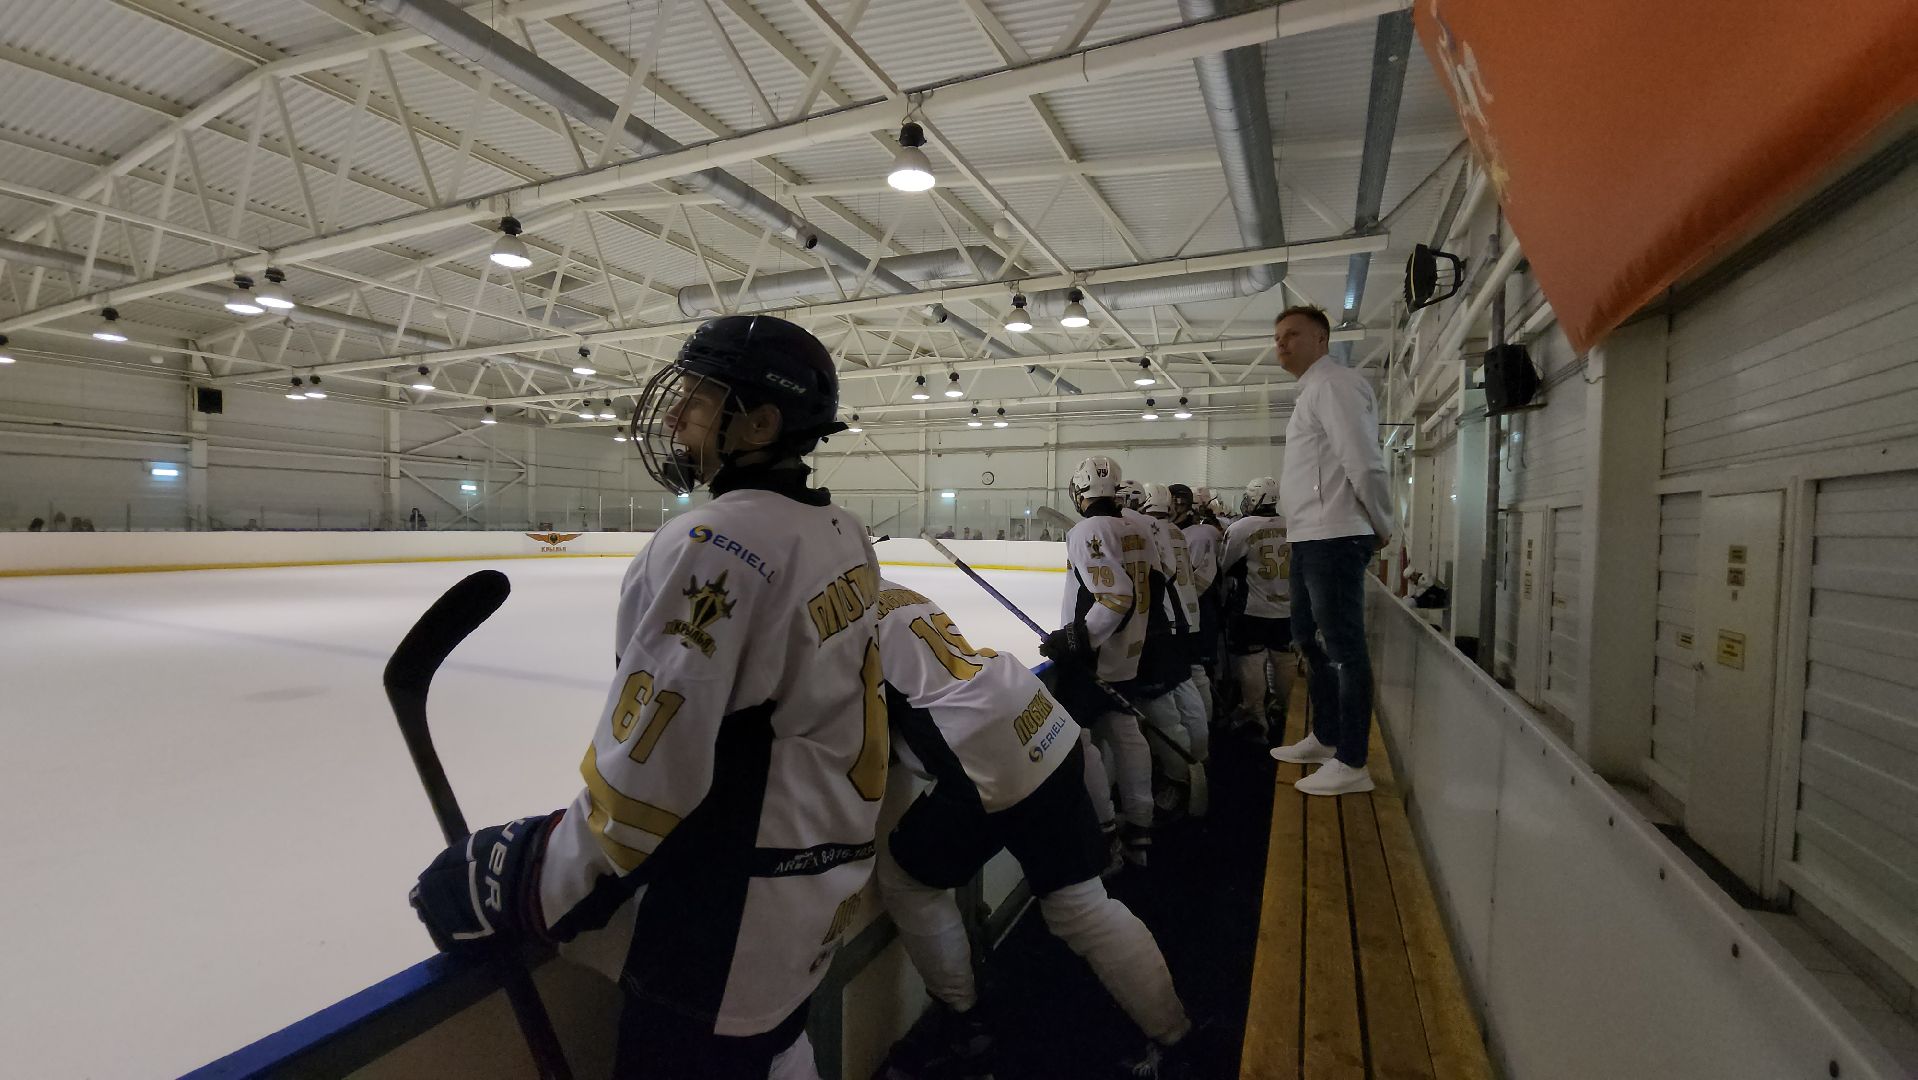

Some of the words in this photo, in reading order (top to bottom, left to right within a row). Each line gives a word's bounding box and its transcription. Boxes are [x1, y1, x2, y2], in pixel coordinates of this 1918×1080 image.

[765, 373, 807, 394] CCM
[712, 534, 775, 584] ERIELL
[1087, 566, 1115, 587] 79
[1258, 544, 1290, 580] 52
[807, 563, 877, 646] ПЛОТ
[612, 670, 686, 764] 61
[1040, 716, 1066, 750] ERIELL
[484, 817, 527, 913] UER
